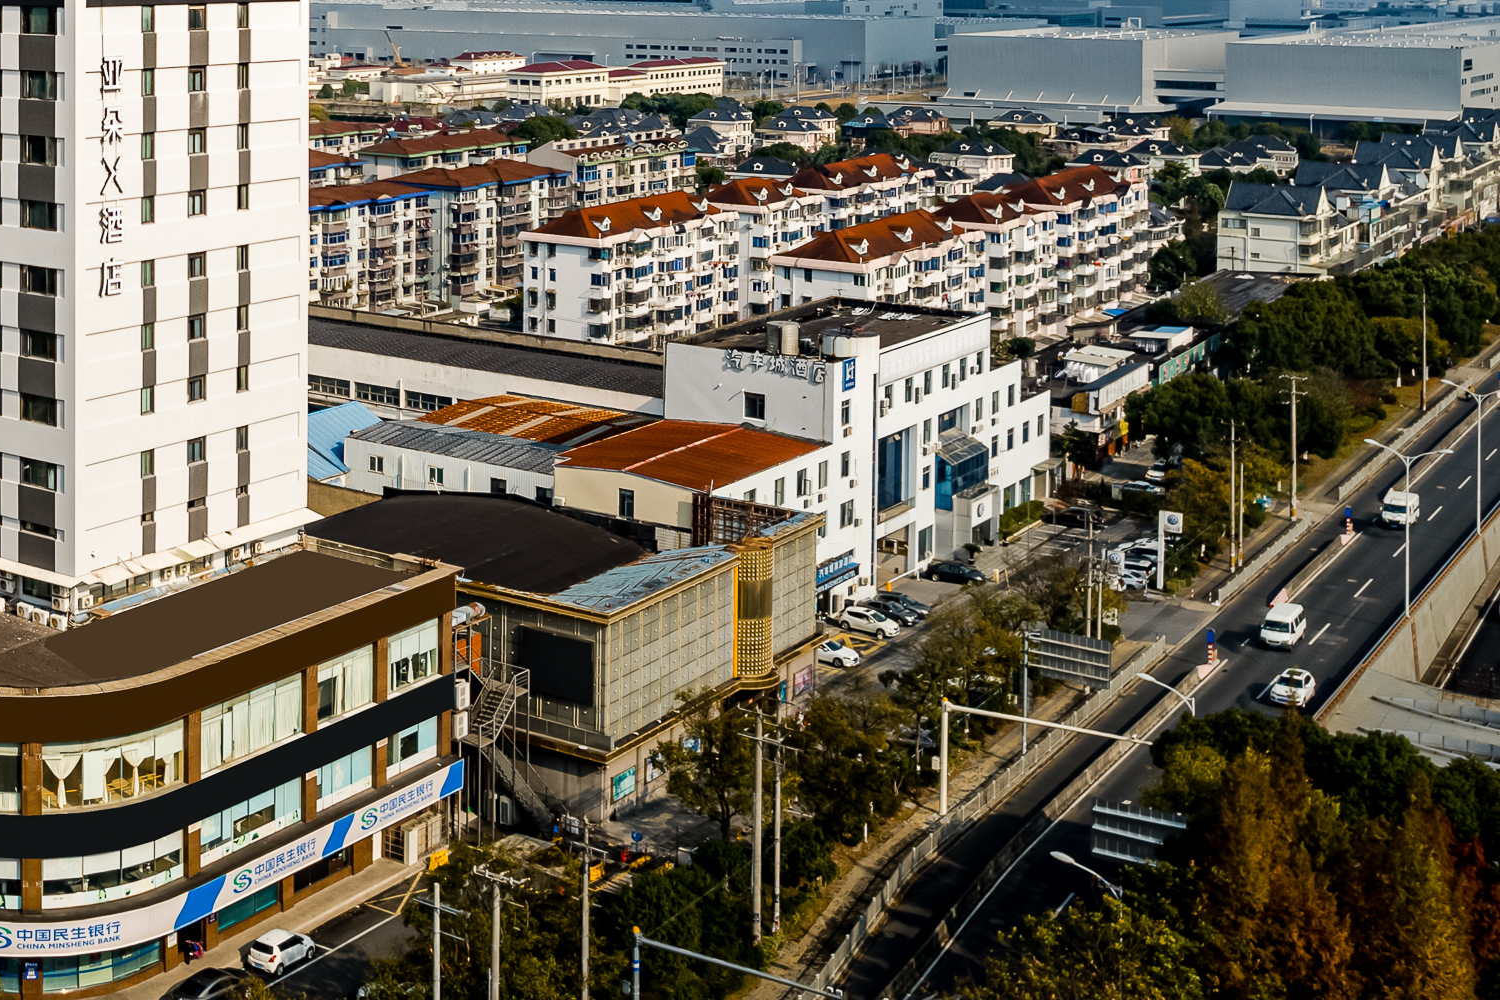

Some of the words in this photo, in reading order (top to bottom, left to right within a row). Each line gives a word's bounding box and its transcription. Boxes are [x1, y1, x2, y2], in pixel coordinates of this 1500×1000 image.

[100, 56, 125, 297] 亚朵X酒店
[727, 348, 826, 383] 汽车城酒店
[379, 779, 434, 814] 中国民生银行
[379, 812, 397, 823] CHINA
[397, 800, 421, 816] MINSHENG
[421, 792, 434, 804] BANK
[254, 838, 317, 875] 中国民生银行
[254, 874, 272, 885] CHINA
[272, 861, 301, 877] MINSHENG
[301, 851, 317, 864] BANK
[16, 920, 121, 942] 中国民生银行
[16, 942, 46, 950] CHINA
[48, 939, 95, 949] MINSHENG
[97, 934, 121, 945] BANK
